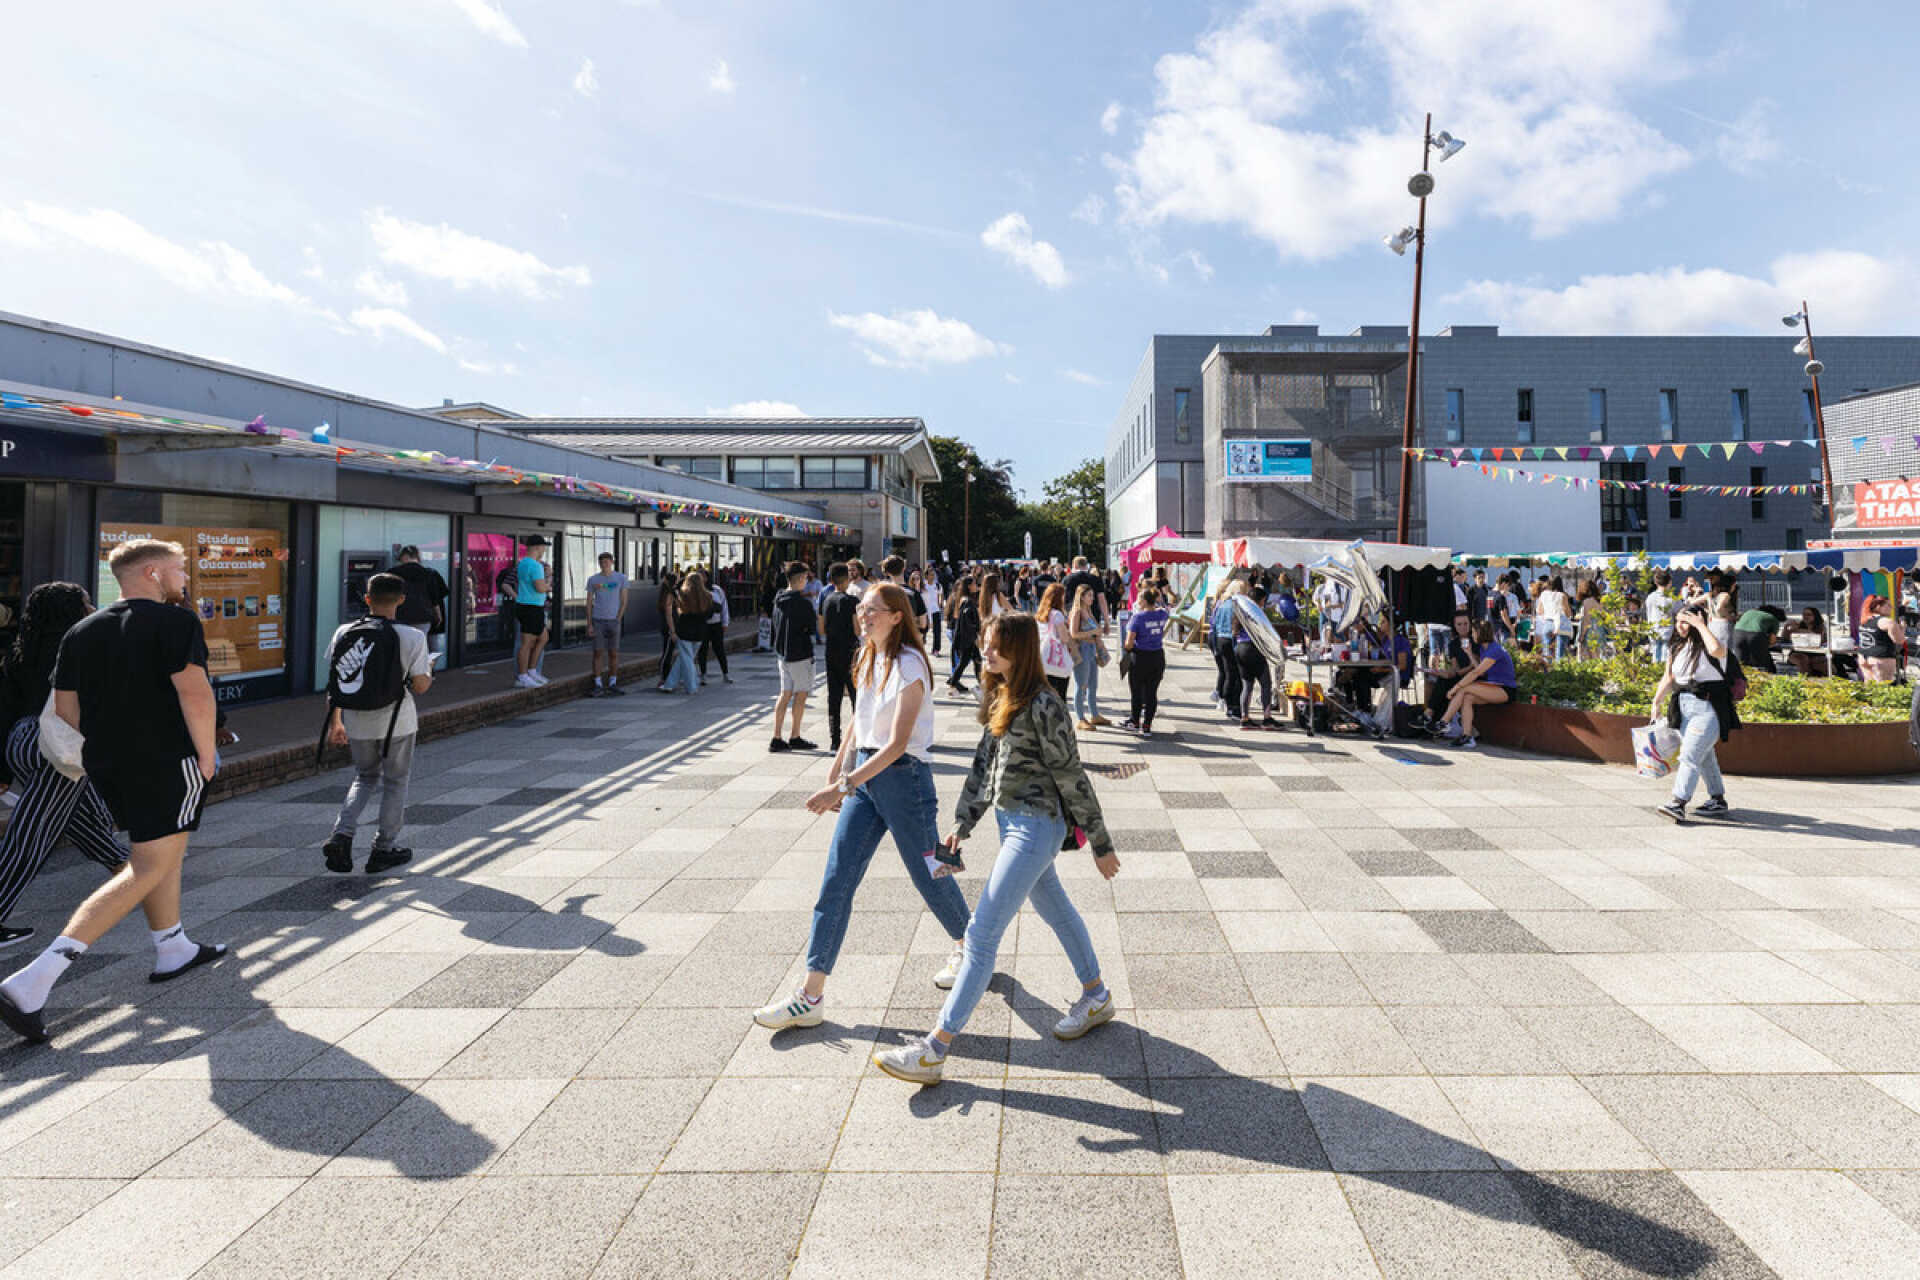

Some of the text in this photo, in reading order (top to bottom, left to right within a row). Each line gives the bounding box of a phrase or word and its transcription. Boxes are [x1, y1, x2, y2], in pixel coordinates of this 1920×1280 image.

[2, 440, 16, 457] P
[1864, 482, 1920, 501] A TAS
[197, 533, 249, 545] Student
[199, 559, 266, 569] Guarantee
[336, 636, 368, 681] NIKE
[214, 683, 246, 701] ERY
